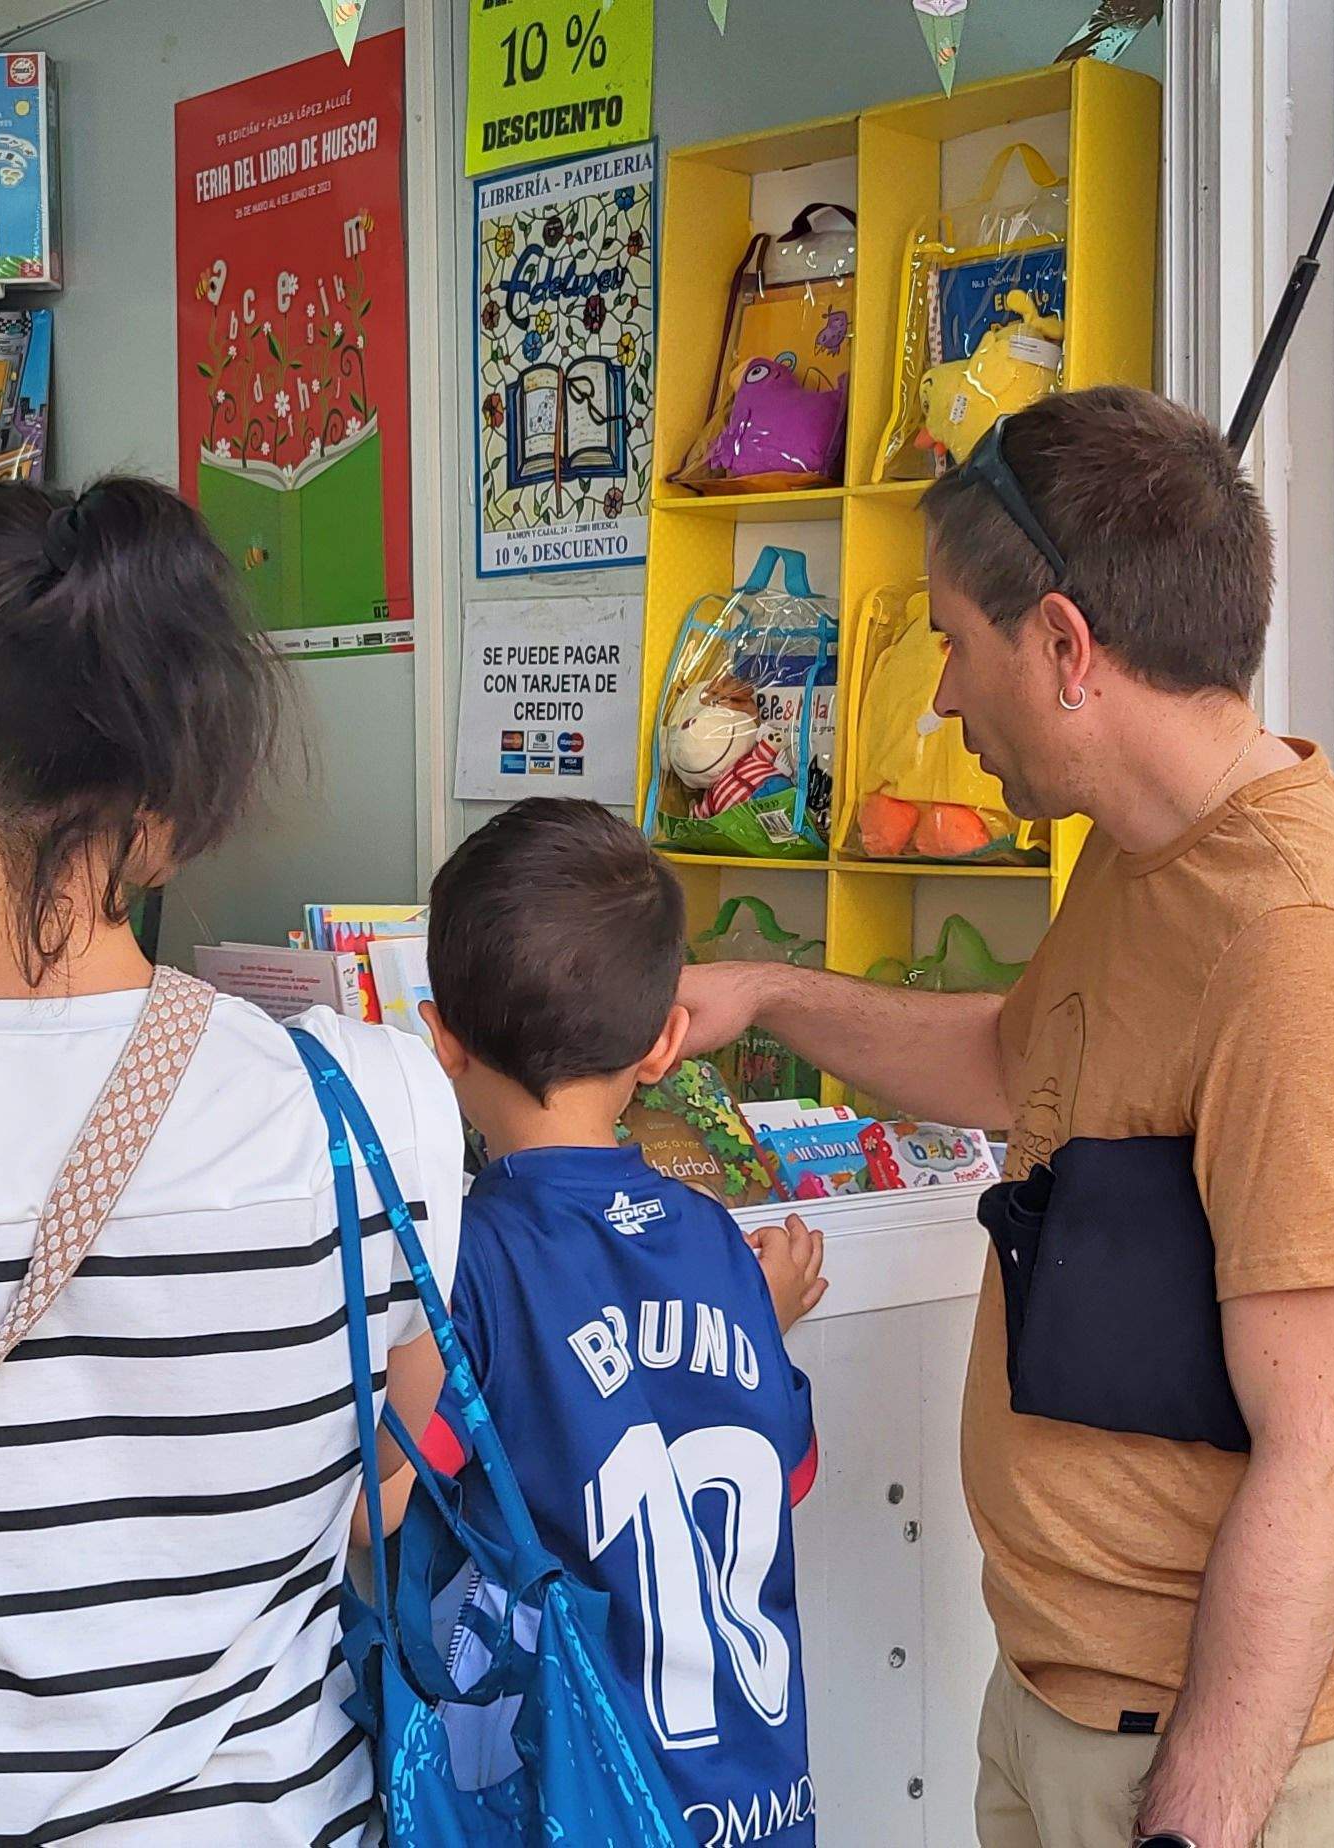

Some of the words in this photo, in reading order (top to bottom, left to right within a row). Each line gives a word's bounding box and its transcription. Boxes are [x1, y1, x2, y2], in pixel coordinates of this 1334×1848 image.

[500, 22, 548, 88] 10
[566, 9, 607, 75] %
[268, 112, 294, 130] PLAZA
[482, 95, 623, 152] DESCUENTO
[196, 163, 230, 203] FERIA
[235, 156, 256, 192] DEL
[260, 143, 297, 184] LIBRO
[301, 135, 318, 170] DE
[322, 118, 378, 164] HUESCA
[481, 173, 550, 209] LIBRERÍA
[563, 153, 653, 190] PAPELERIA
[507, 530, 530, 541] RAMON
[591, 521, 618, 532] HUESCA
[495, 547, 510, 566] 10
[513, 545, 528, 565] %
[532, 535, 628, 564] DESCUENTO
[483, 647, 502, 666] SE
[507, 646, 559, 665] PUEDE
[564, 645, 620, 664] PAGAR
[483, 674, 517, 693] CON
[522, 673, 591, 693] TARJETA
[595, 674, 617, 692] DE
[514, 702, 583, 721] CREDITO
[534, 761, 551, 769] VISA
[794, 1142, 845, 1161] MUNDO
[673, 1154, 720, 1177] árbol
[568, 1300, 762, 1399] BRUNO
[584, 1421, 792, 1750] 10
